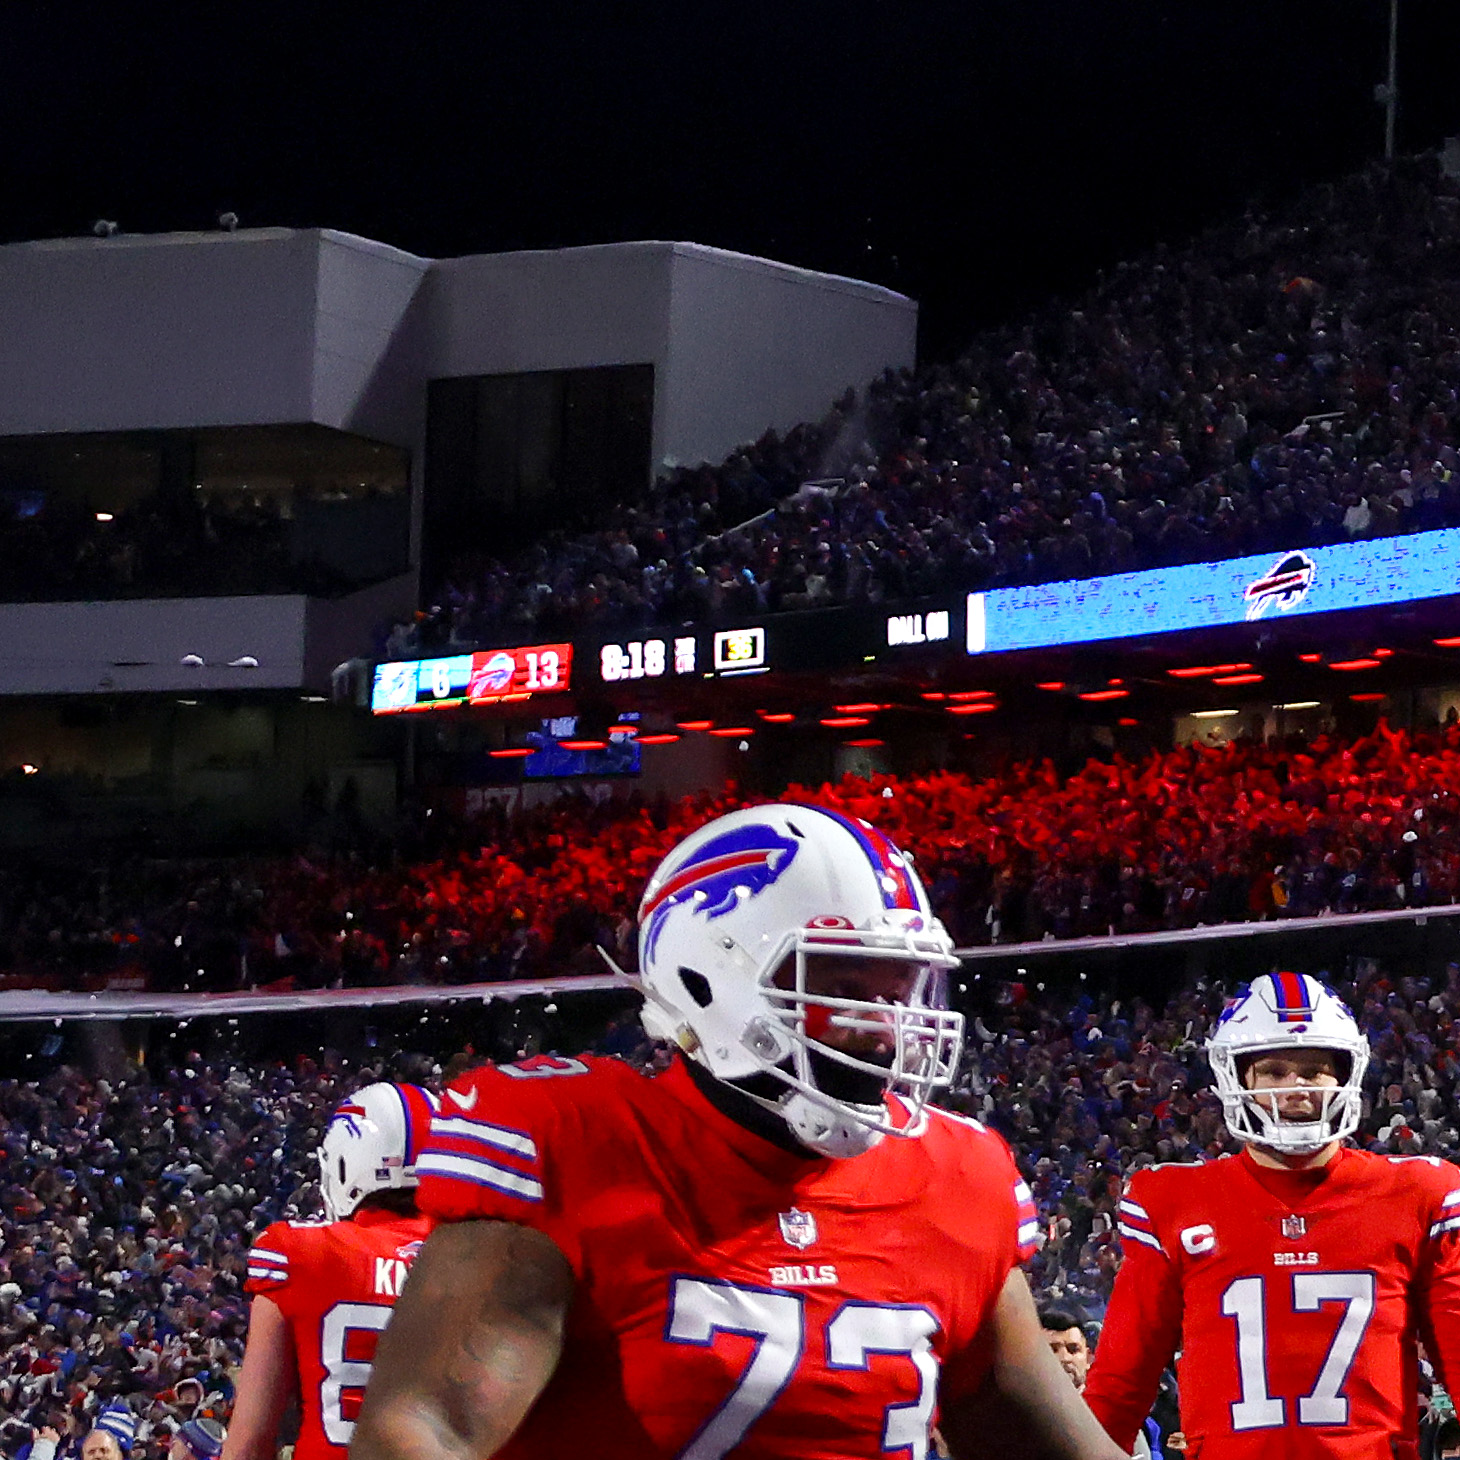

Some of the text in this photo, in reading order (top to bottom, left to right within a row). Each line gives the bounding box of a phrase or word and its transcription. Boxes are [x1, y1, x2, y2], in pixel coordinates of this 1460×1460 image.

[525, 651, 559, 689] 13
[601, 639, 666, 681] 8:18
[1180, 1224, 1217, 1256] C
[768, 1265, 839, 1286] BILLS
[1273, 1252, 1320, 1266] BILLS
[1220, 1270, 1377, 1433] 17
